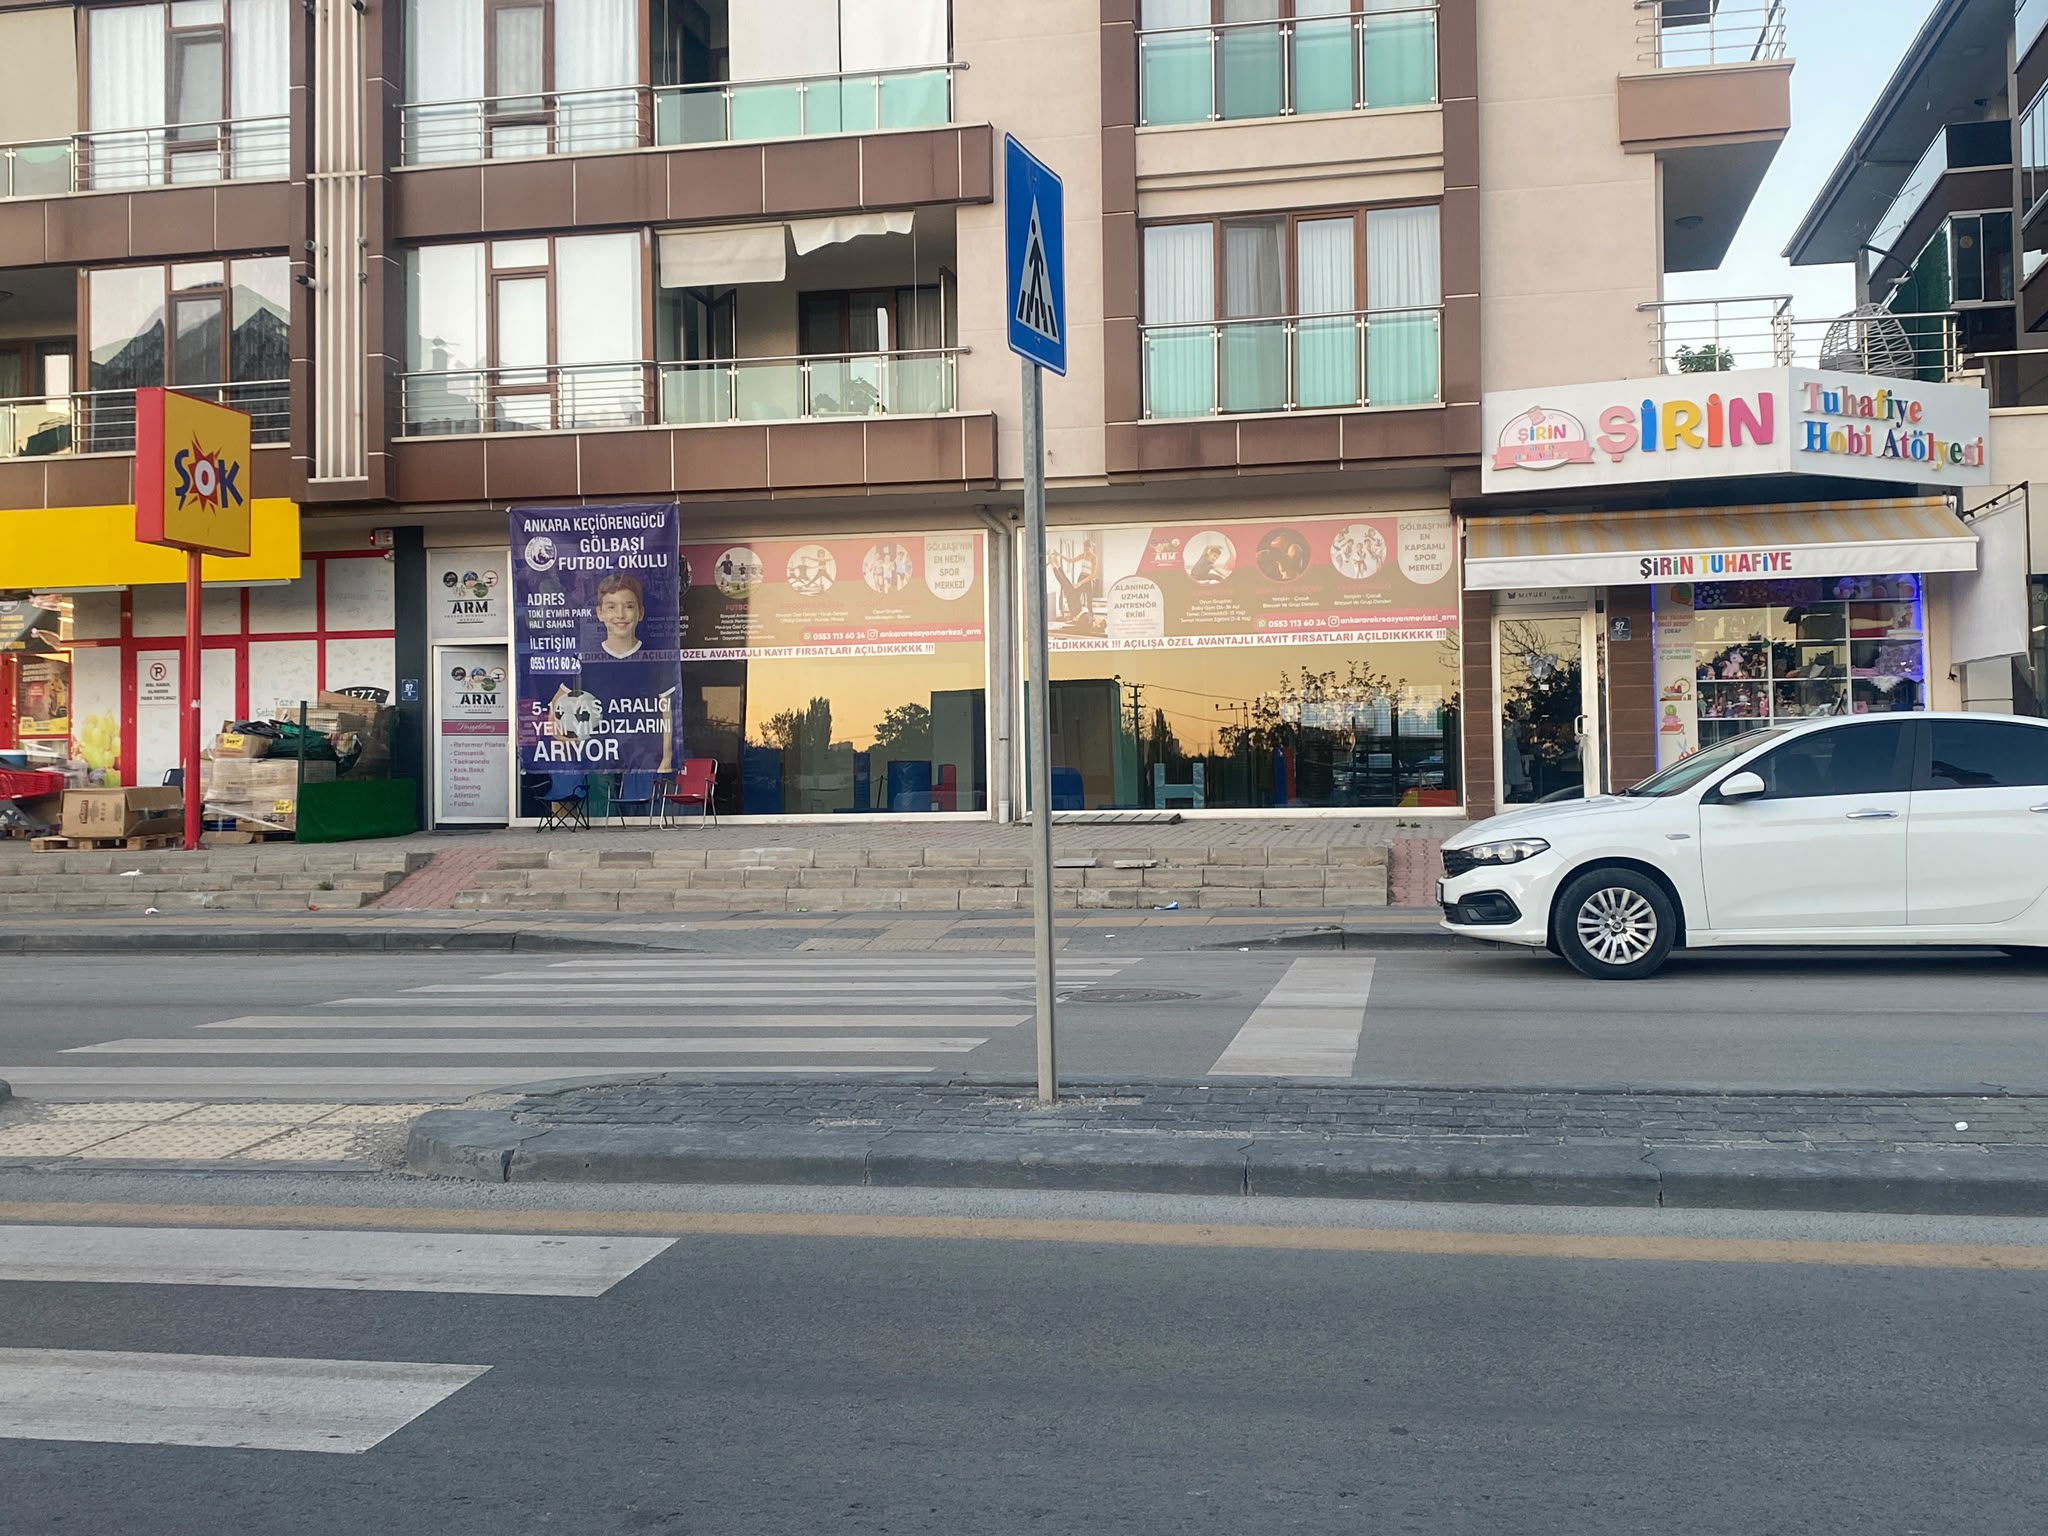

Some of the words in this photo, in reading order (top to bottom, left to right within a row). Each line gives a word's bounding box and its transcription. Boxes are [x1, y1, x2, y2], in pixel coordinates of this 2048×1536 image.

[1802, 381, 1922, 428] Tuhafiye
[1597, 392, 1774, 463] ŞİRİN
[1803, 420, 1872, 456] Hobi
[1881, 429, 1985, 471] Atölyesi
[174, 448, 243, 511] ŞOK
[523, 517, 571, 533] ANKARA
[573, 511, 665, 534] KEÇİÖRENGÜCÜ
[1419, 533, 1431, 541] EN
[580, 535, 645, 555] GÖLBAŞI
[1405, 543, 1446, 551] KAPSAMLI
[558, 556, 614, 571] FUTBOL
[618, 554, 668, 569] OKULU
[1408, 562, 1443, 571] MERKEZİ
[1640, 555, 1694, 579] ŞİRİN
[1699, 551, 1793, 574] TUHAFİYE
[940, 568, 960, 577] SPOR
[935, 579, 965, 589] MERKEZİ
[527, 592, 566, 606] ADRES
[452, 601, 488, 614] ARM
[527, 608, 544, 618] TOKİ
[545, 608, 570, 618] EYMİR
[571, 608, 592, 617] PARK
[528, 620, 545, 629] HALI
[546, 619, 575, 629] SAHASI
[1268, 619, 1288, 627] 0553
[1289, 619, 1302, 627] 113
[1303, 619, 1314, 627] 60
[1316, 618, 1326, 626] 24
[813, 632, 831, 640] 0553
[832, 632, 844, 640] 113
[1198, 635, 1254, 646] AVANTAJLI
[1257, 635, 1289, 644] KAYIT
[1291, 632, 1354, 643] FIRSATLARI
[529, 634, 576, 653] İLETİŞİM
[709, 648, 762, 658] AVANTAJLI
[764, 647, 793, 657] KAYIT
[796, 646, 852, 656] FIRSATLARI
[530, 656, 545, 670] 0553
[546, 656, 559, 670] 113
[560, 656, 570, 670] 60
[571, 656, 581, 670] 24
[460, 694, 496, 705] ARM
[533, 738, 619, 762] ARIYOR
